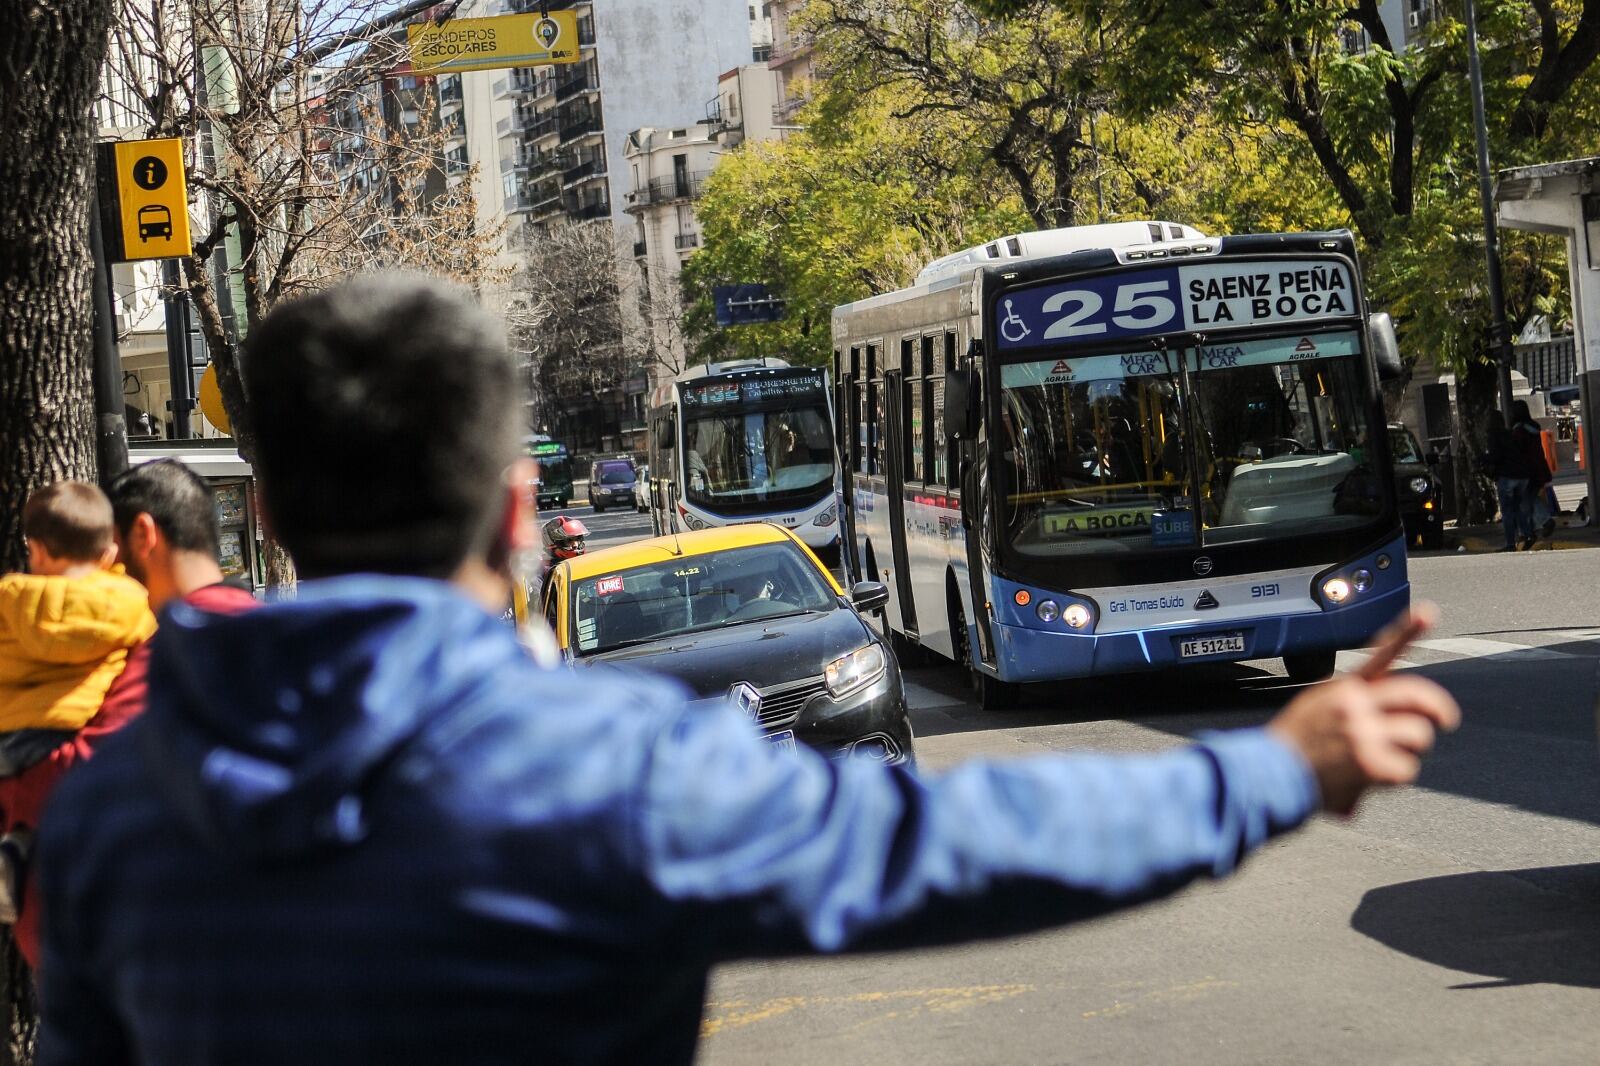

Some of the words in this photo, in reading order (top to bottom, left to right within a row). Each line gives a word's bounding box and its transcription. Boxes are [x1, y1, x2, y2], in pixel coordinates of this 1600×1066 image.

[422, 28, 496, 44] SENDEROS
[422, 41, 497, 57] ESCOLARES
[1189, 274, 1272, 302] SAENZ
[1279, 265, 1345, 294] PEÑA
[1042, 281, 1178, 340] 25
[1192, 301, 1234, 324] LA
[1251, 292, 1346, 319] BOCA
[1120, 353, 1163, 366] MEGA
[1201, 346, 1246, 359] MEGA
[1288, 351, 1321, 361] AGRALE
[1127, 363, 1156, 375] CAR
[1209, 355, 1238, 368] CAR
[1044, 374, 1077, 384] AGRALE
[1051, 518, 1079, 533] LA
[1086, 511, 1149, 531] BOCA
[1155, 520, 1191, 535] SUBE
[599, 578, 622, 593] LIBRE
[1251, 583, 1280, 598] 9131
[1110, 600, 1129, 613] Gral.
[1130, 599, 1158, 611] Tomas
[1159, 595, 1184, 609] Guido
[1184, 643, 1199, 656] AE
[1201, 640, 1224, 653] 512
